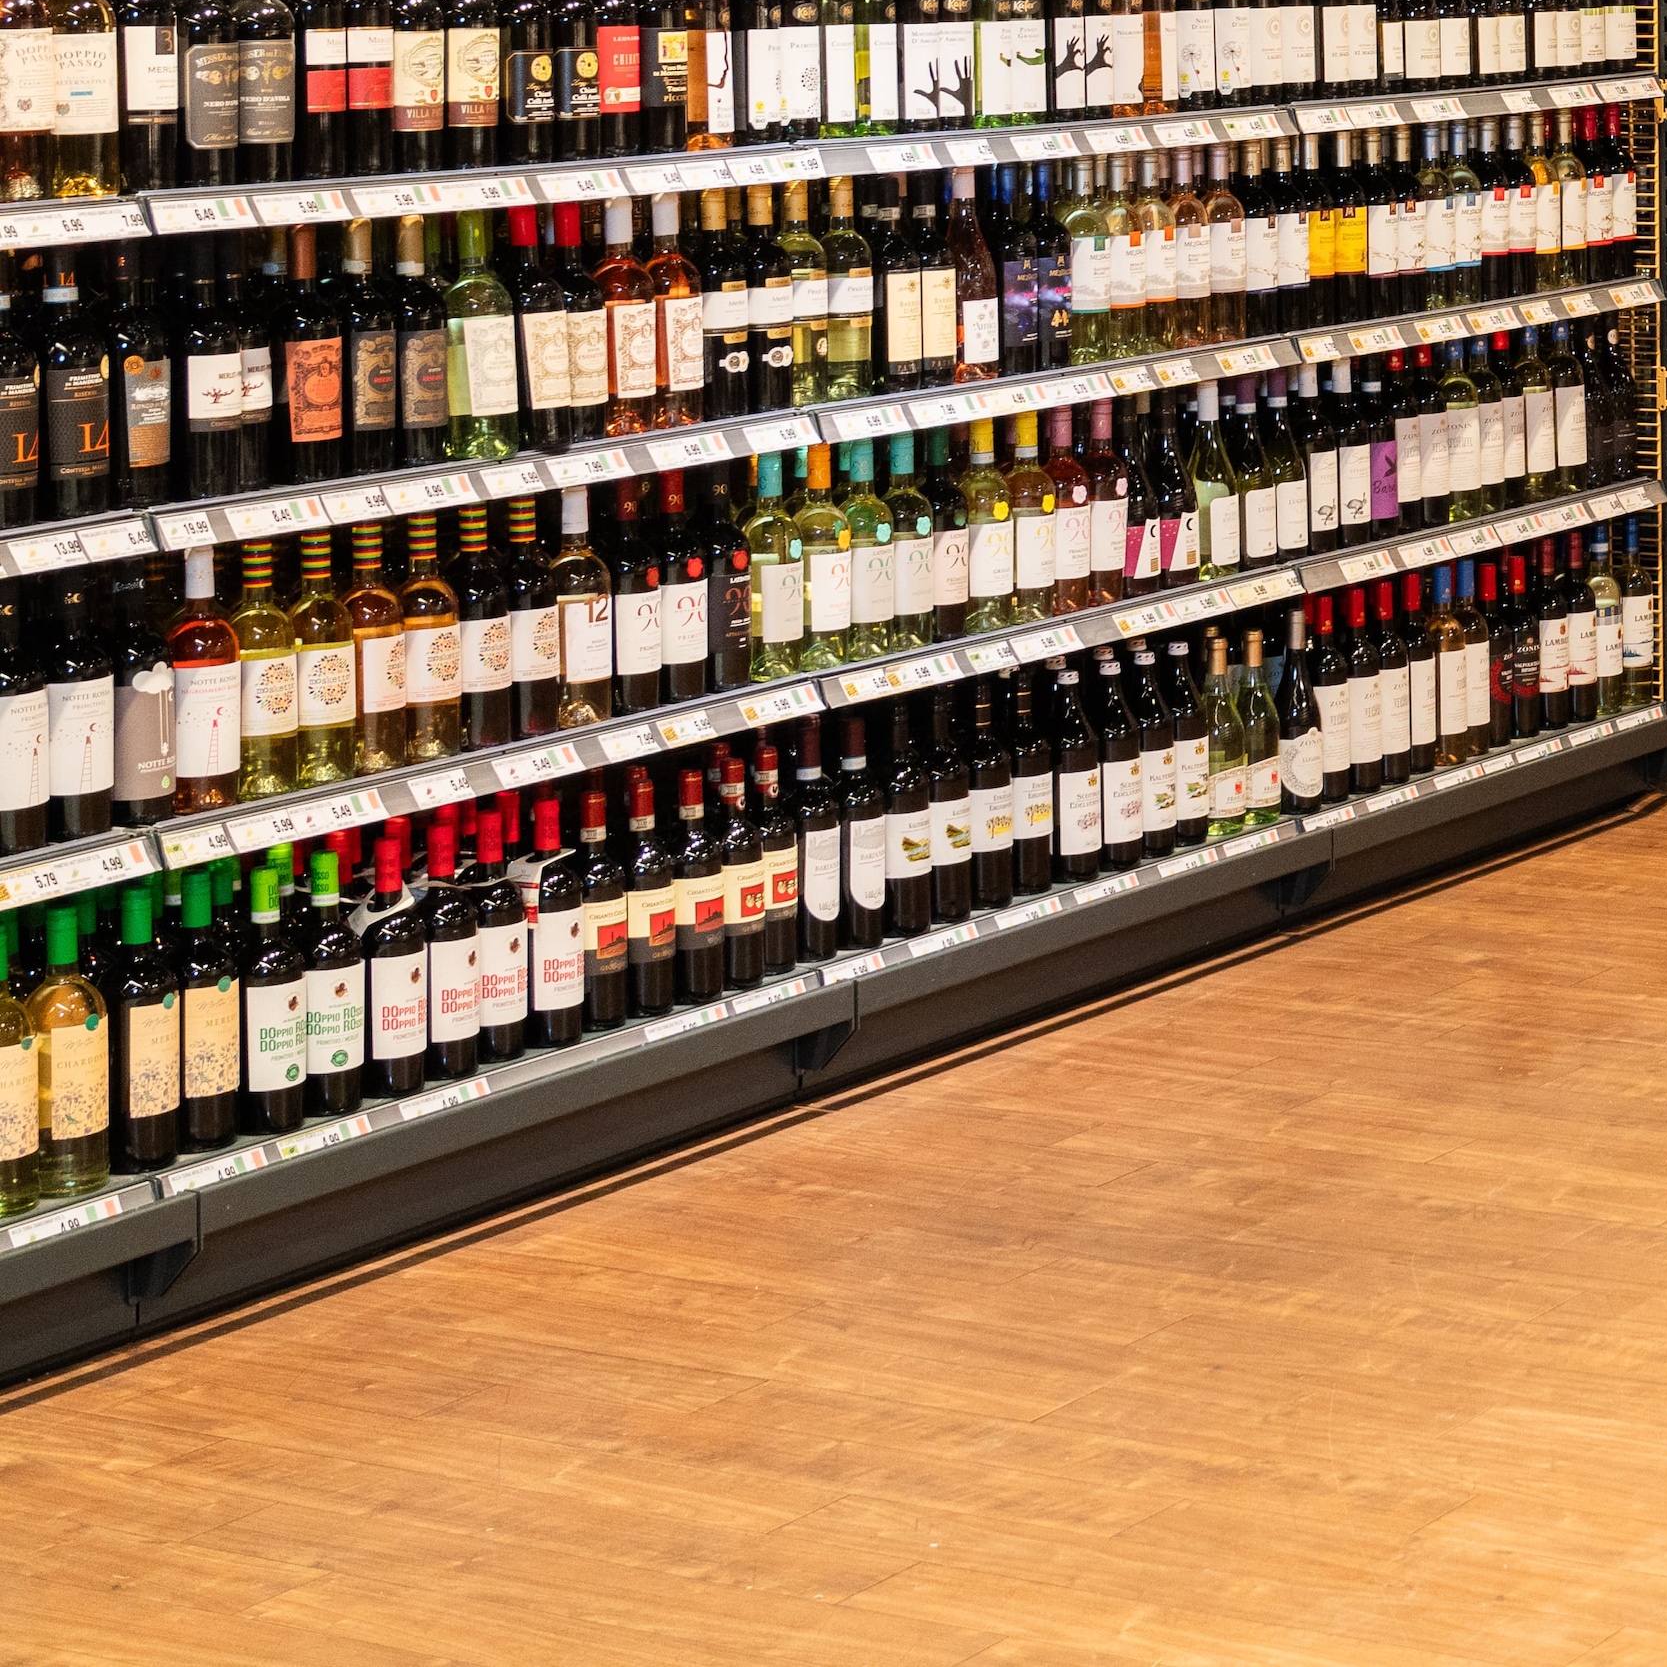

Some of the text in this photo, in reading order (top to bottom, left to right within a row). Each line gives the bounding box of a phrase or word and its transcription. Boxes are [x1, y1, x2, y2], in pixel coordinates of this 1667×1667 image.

[194, 207, 215, 222] 6.49
[62, 218, 84, 232] 6.99
[60, 272, 74, 286] 14
[424, 483, 444, 498] 8.99
[183, 519, 210, 537] 19.99
[54, 540, 81, 557] 13.99
[583, 596, 608, 622] 12
[272, 818, 294, 832] 5.99
[102, 856, 121, 872] 4.99
[34, 872, 57, 888] 5.79
